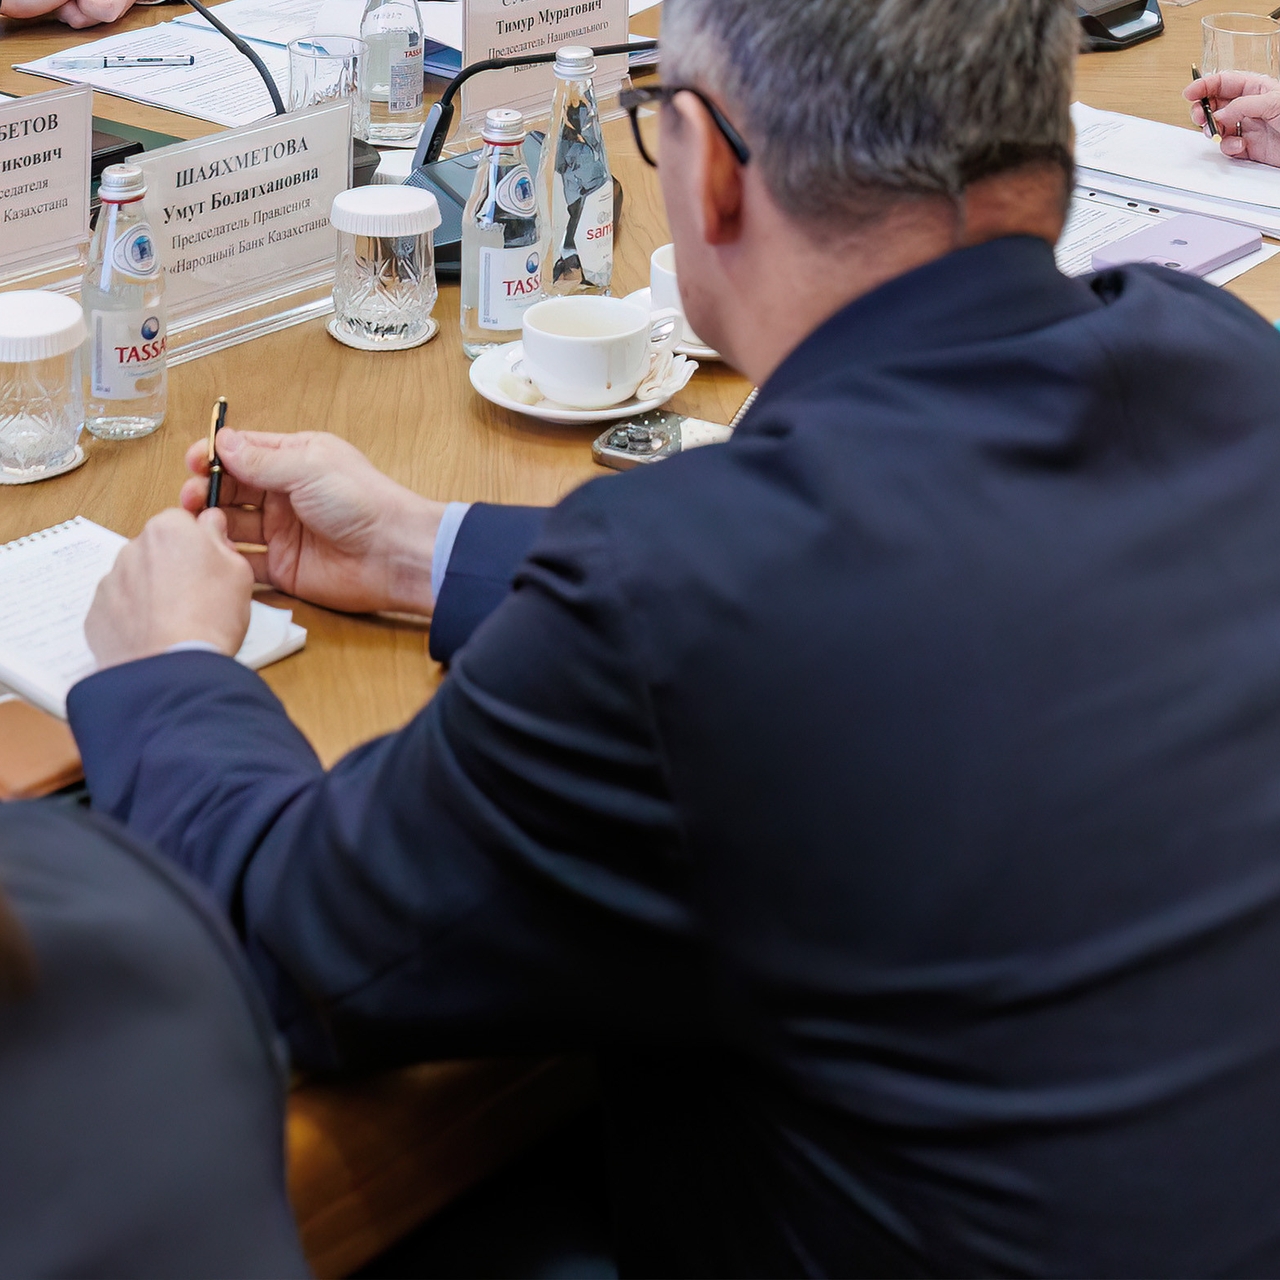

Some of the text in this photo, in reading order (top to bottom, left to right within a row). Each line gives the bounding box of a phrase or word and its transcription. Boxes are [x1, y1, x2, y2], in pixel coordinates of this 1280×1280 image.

[496, 0, 603, 35] Тимур Муратович
[488, 20, 609, 61] Председатель Национального
[175, 135, 309, 189] ШАЯХМЕТОВА
[4, 197, 69, 224] Казахстана
[163, 166, 320, 225] Умут Болатхановна
[171, 197, 312, 251] Председатель Правления
[169, 243, 236, 276] «Народный
[238, 235, 265, 254] Банк
[502, 274, 542, 296] TASS
